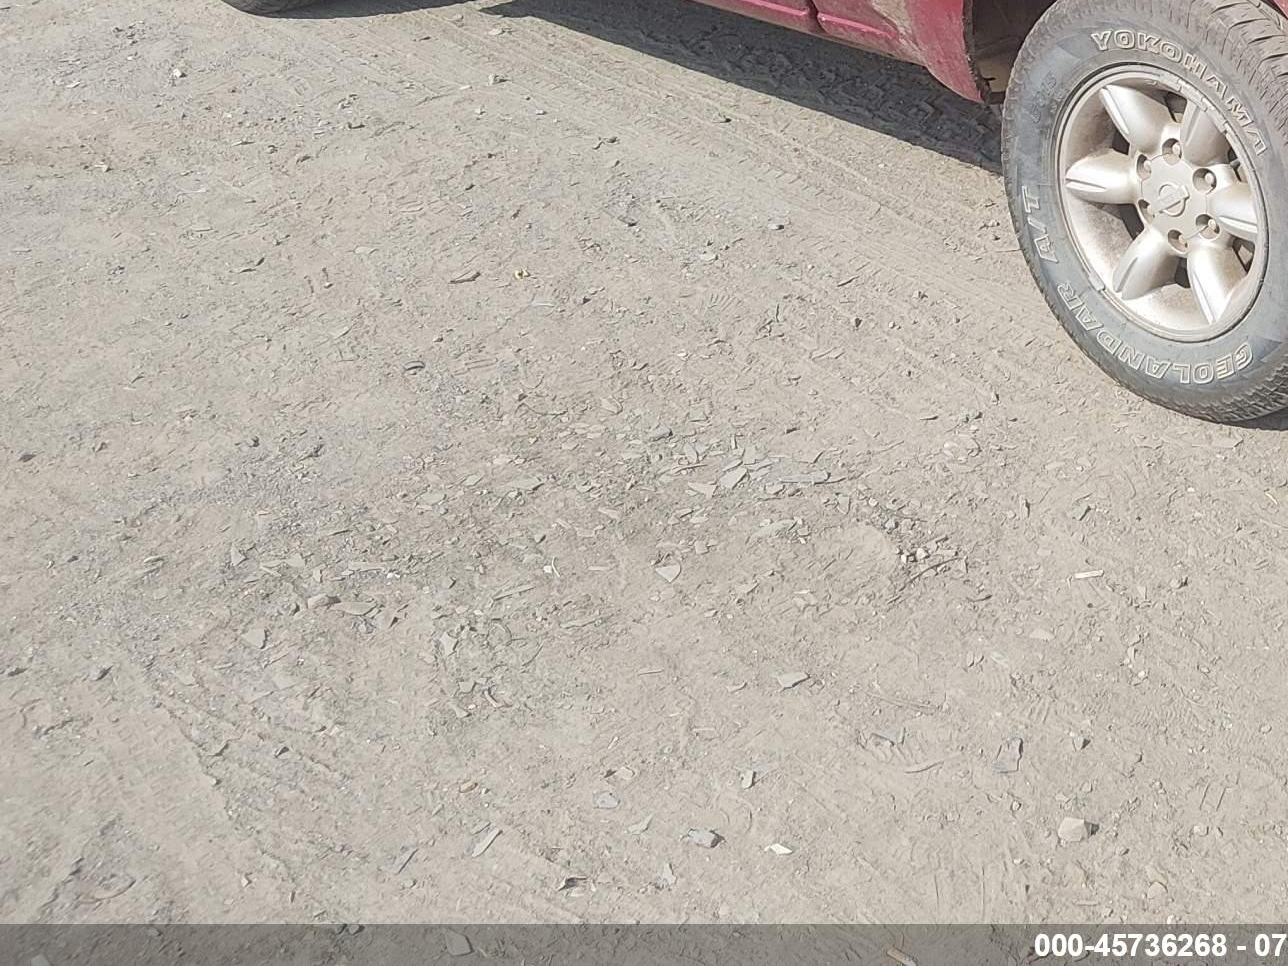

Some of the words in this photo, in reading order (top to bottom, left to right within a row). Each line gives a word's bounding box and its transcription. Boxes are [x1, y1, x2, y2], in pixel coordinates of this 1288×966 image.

[1090, 28, 1267, 157] YOKOHAMA
[1021, 185, 1059, 265] A/T
[1056, 283, 1255, 386] GEOLANDAR
